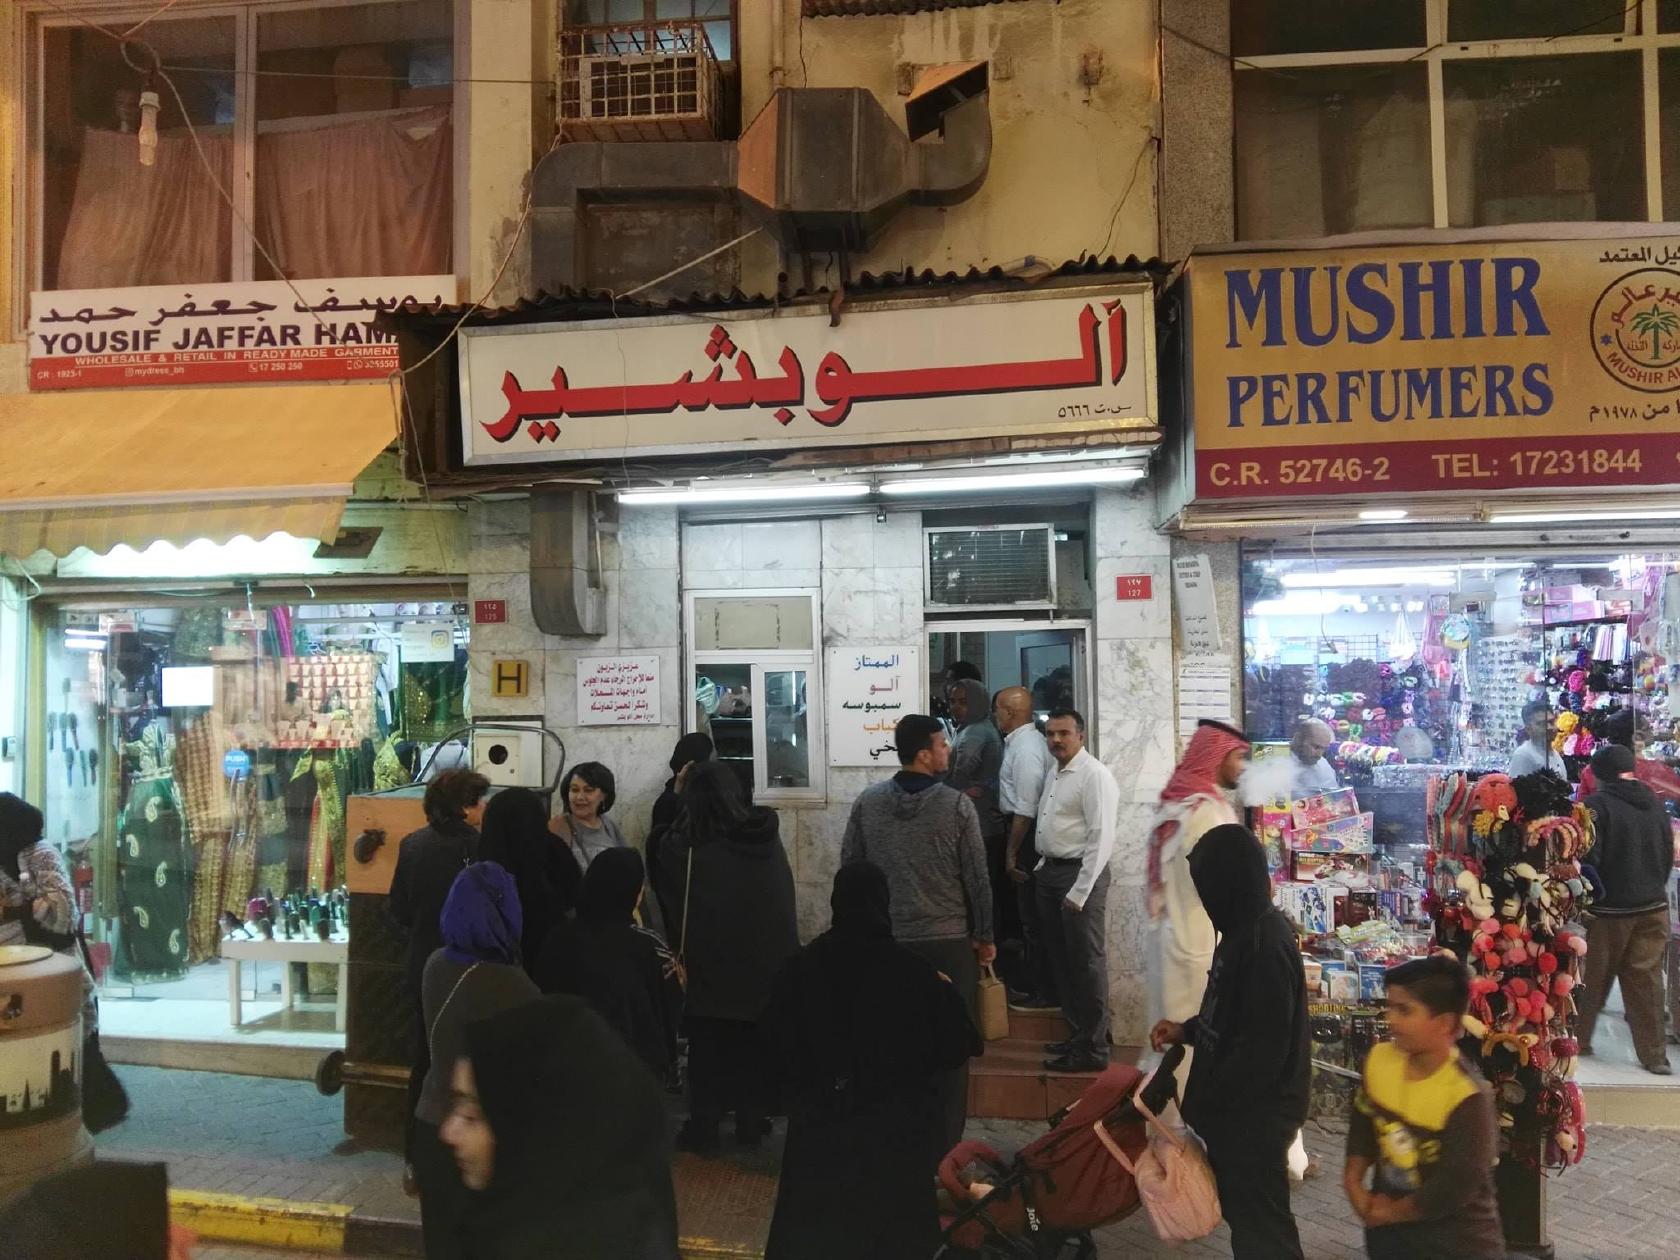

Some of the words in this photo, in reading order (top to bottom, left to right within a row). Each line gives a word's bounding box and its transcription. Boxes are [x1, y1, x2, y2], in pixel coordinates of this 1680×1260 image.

[1600, 246, 1651, 263] المعتمد
[149, 293, 278, 326] جعفر
[1224, 257, 1551, 348] MUSHIR
[39, 306, 137, 324] حمد
[39, 329, 160, 355] YOUSIF
[172, 324, 302, 350] JAFFAR
[314, 321, 399, 345] HAM
[75, 354, 151, 365] WHOLESALE
[158, 353, 166, 363] &
[174, 351, 217, 362] RETAIL
[224, 351, 236, 360] IN
[244, 350, 287, 359] READY
[290, 348, 327, 358] MADE
[37, 371, 49, 379] CR
[259, 363, 268, 371] 17
[1607, 351, 1663, 384] MUSHIR
[1226, 362, 1555, 428] PERFUMERS
[1058, 404, 1090, 418] ٥٦٦٦
[1642, 404, 1670, 421] من
[1210, 463, 1270, 487] C.R.
[1279, 457, 1391, 485] 52746-2
[1432, 454, 1499, 478] TEL:
[1509, 448, 1642, 476] 17231844
[1127, 589, 1141, 597] 127
[854, 655, 899, 671] الممتاز
[497, 663, 522, 694] H
[869, 675, 902, 695] آلو
[1026, 1207, 1041, 1231] Joie
